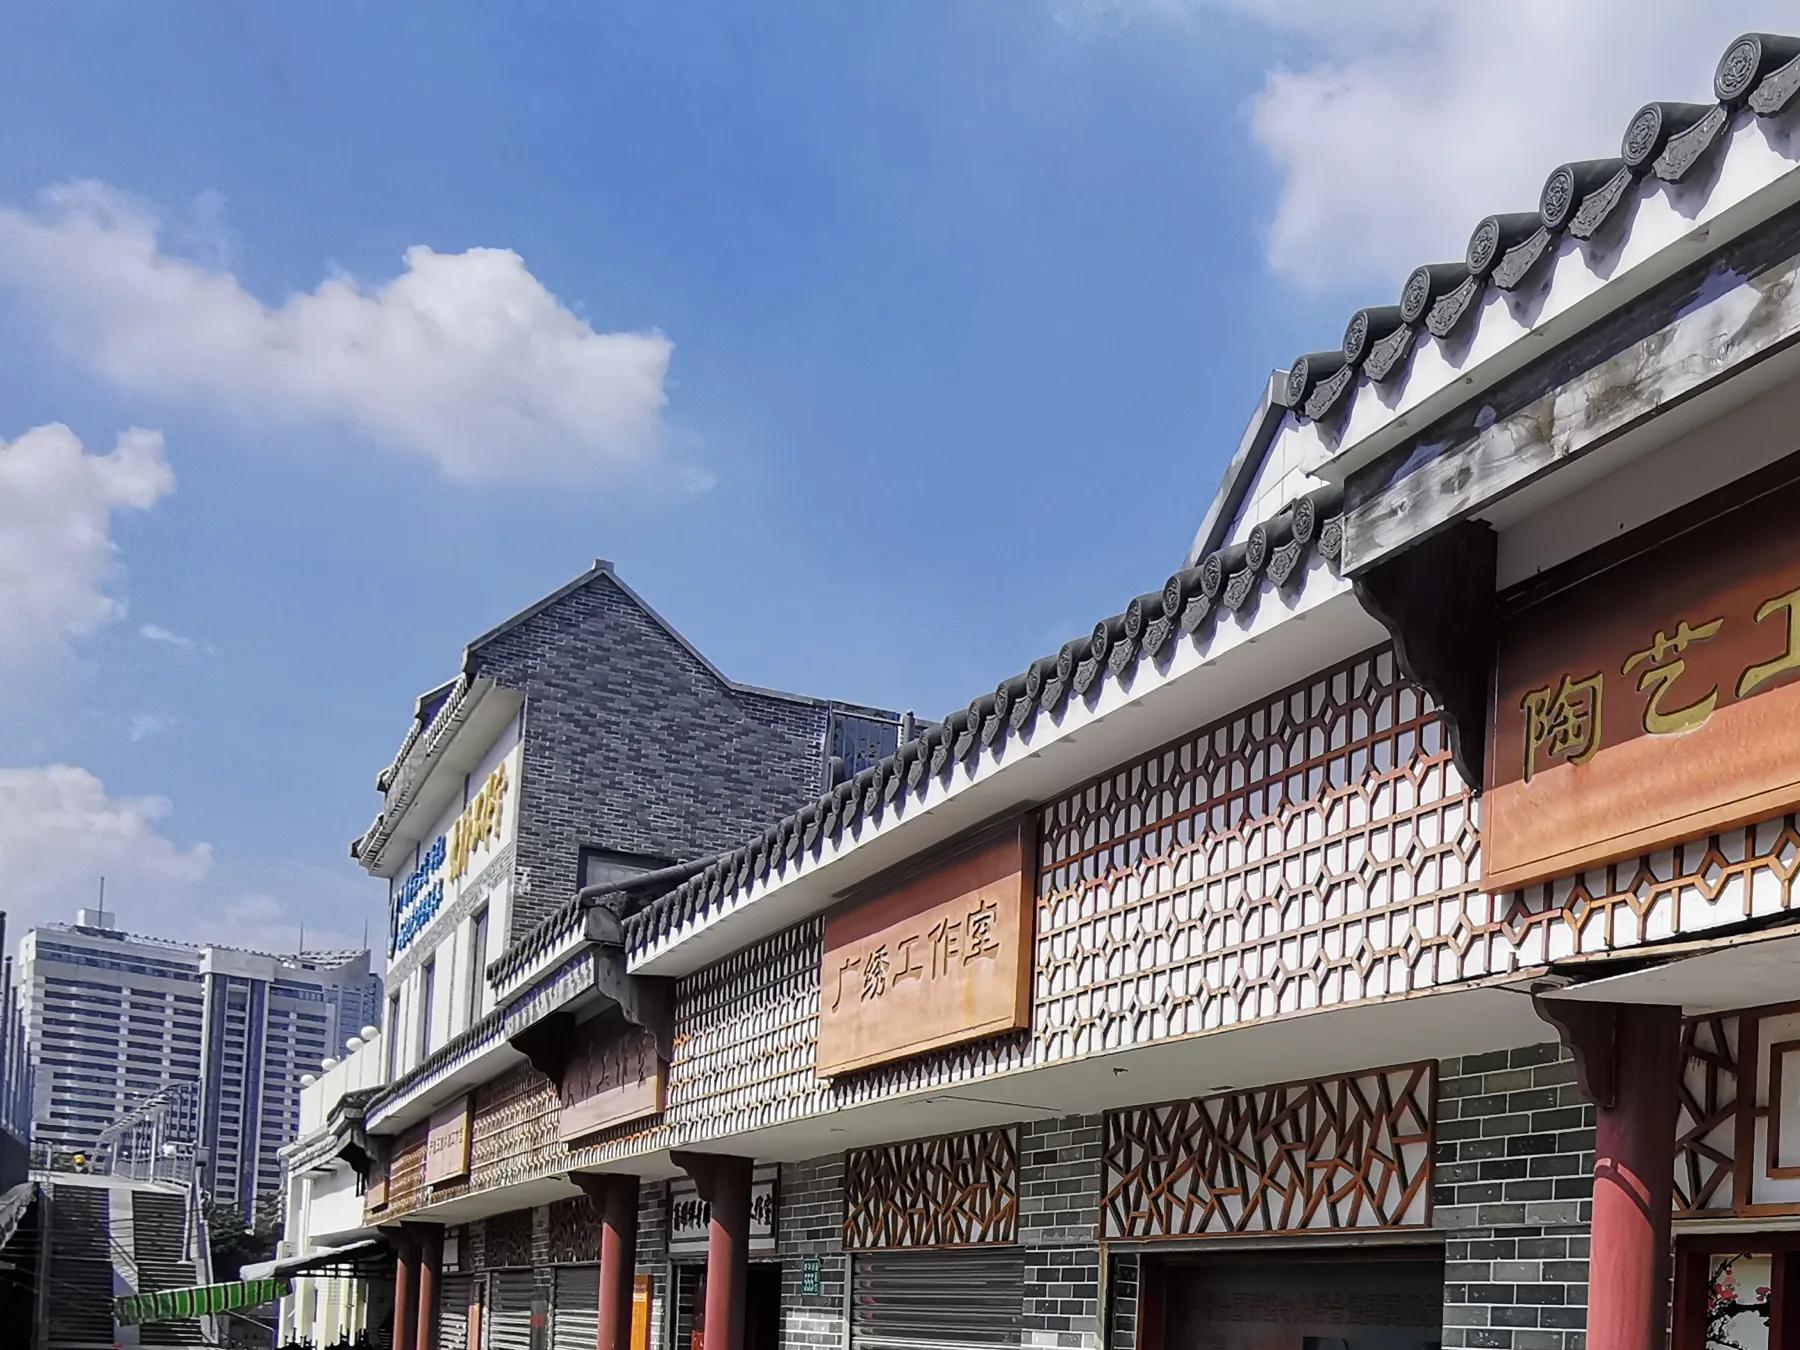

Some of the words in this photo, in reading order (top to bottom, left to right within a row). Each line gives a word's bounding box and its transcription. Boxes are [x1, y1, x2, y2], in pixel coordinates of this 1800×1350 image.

[831, 899, 1000, 1013] 广绣工作室
